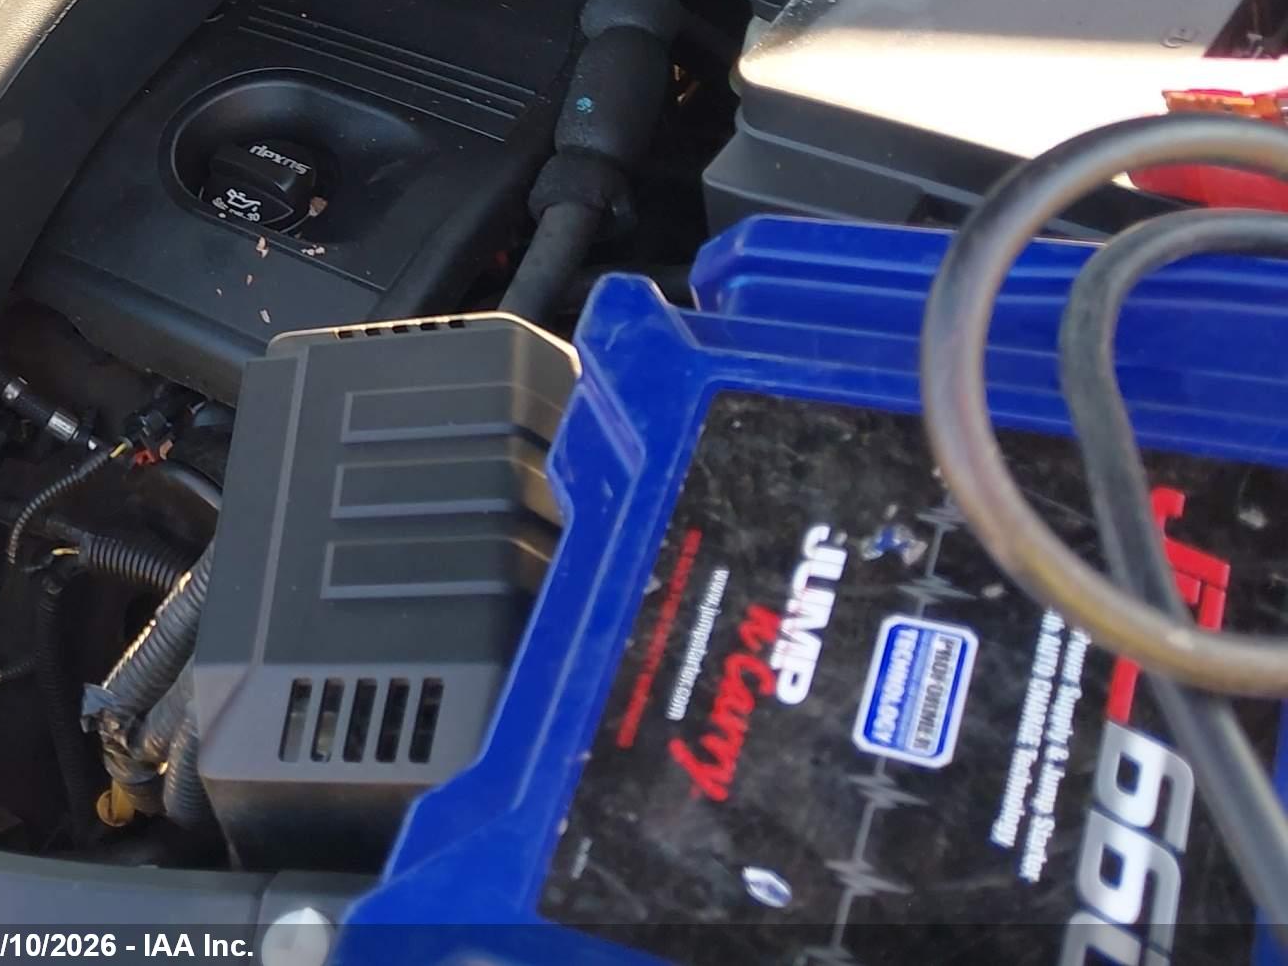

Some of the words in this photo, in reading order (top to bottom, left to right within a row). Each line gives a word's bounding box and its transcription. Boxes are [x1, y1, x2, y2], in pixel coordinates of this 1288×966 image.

[665, 567, 730, 721] www.jumpstarter.com
[769, 523, 848, 705] JUMP
[871, 628, 919, 743] TECHNOLOGY
[1031, 632, 1061, 678] AUTO
[1016, 677, 1053, 747] CHARGE
[1047, 683, 1082, 744] Supply
[1044, 744, 1069, 762] &
[990, 748, 1039, 848] Technology
[1030, 762, 1065, 814] Jump
[1019, 815, 1055, 883] Starter
